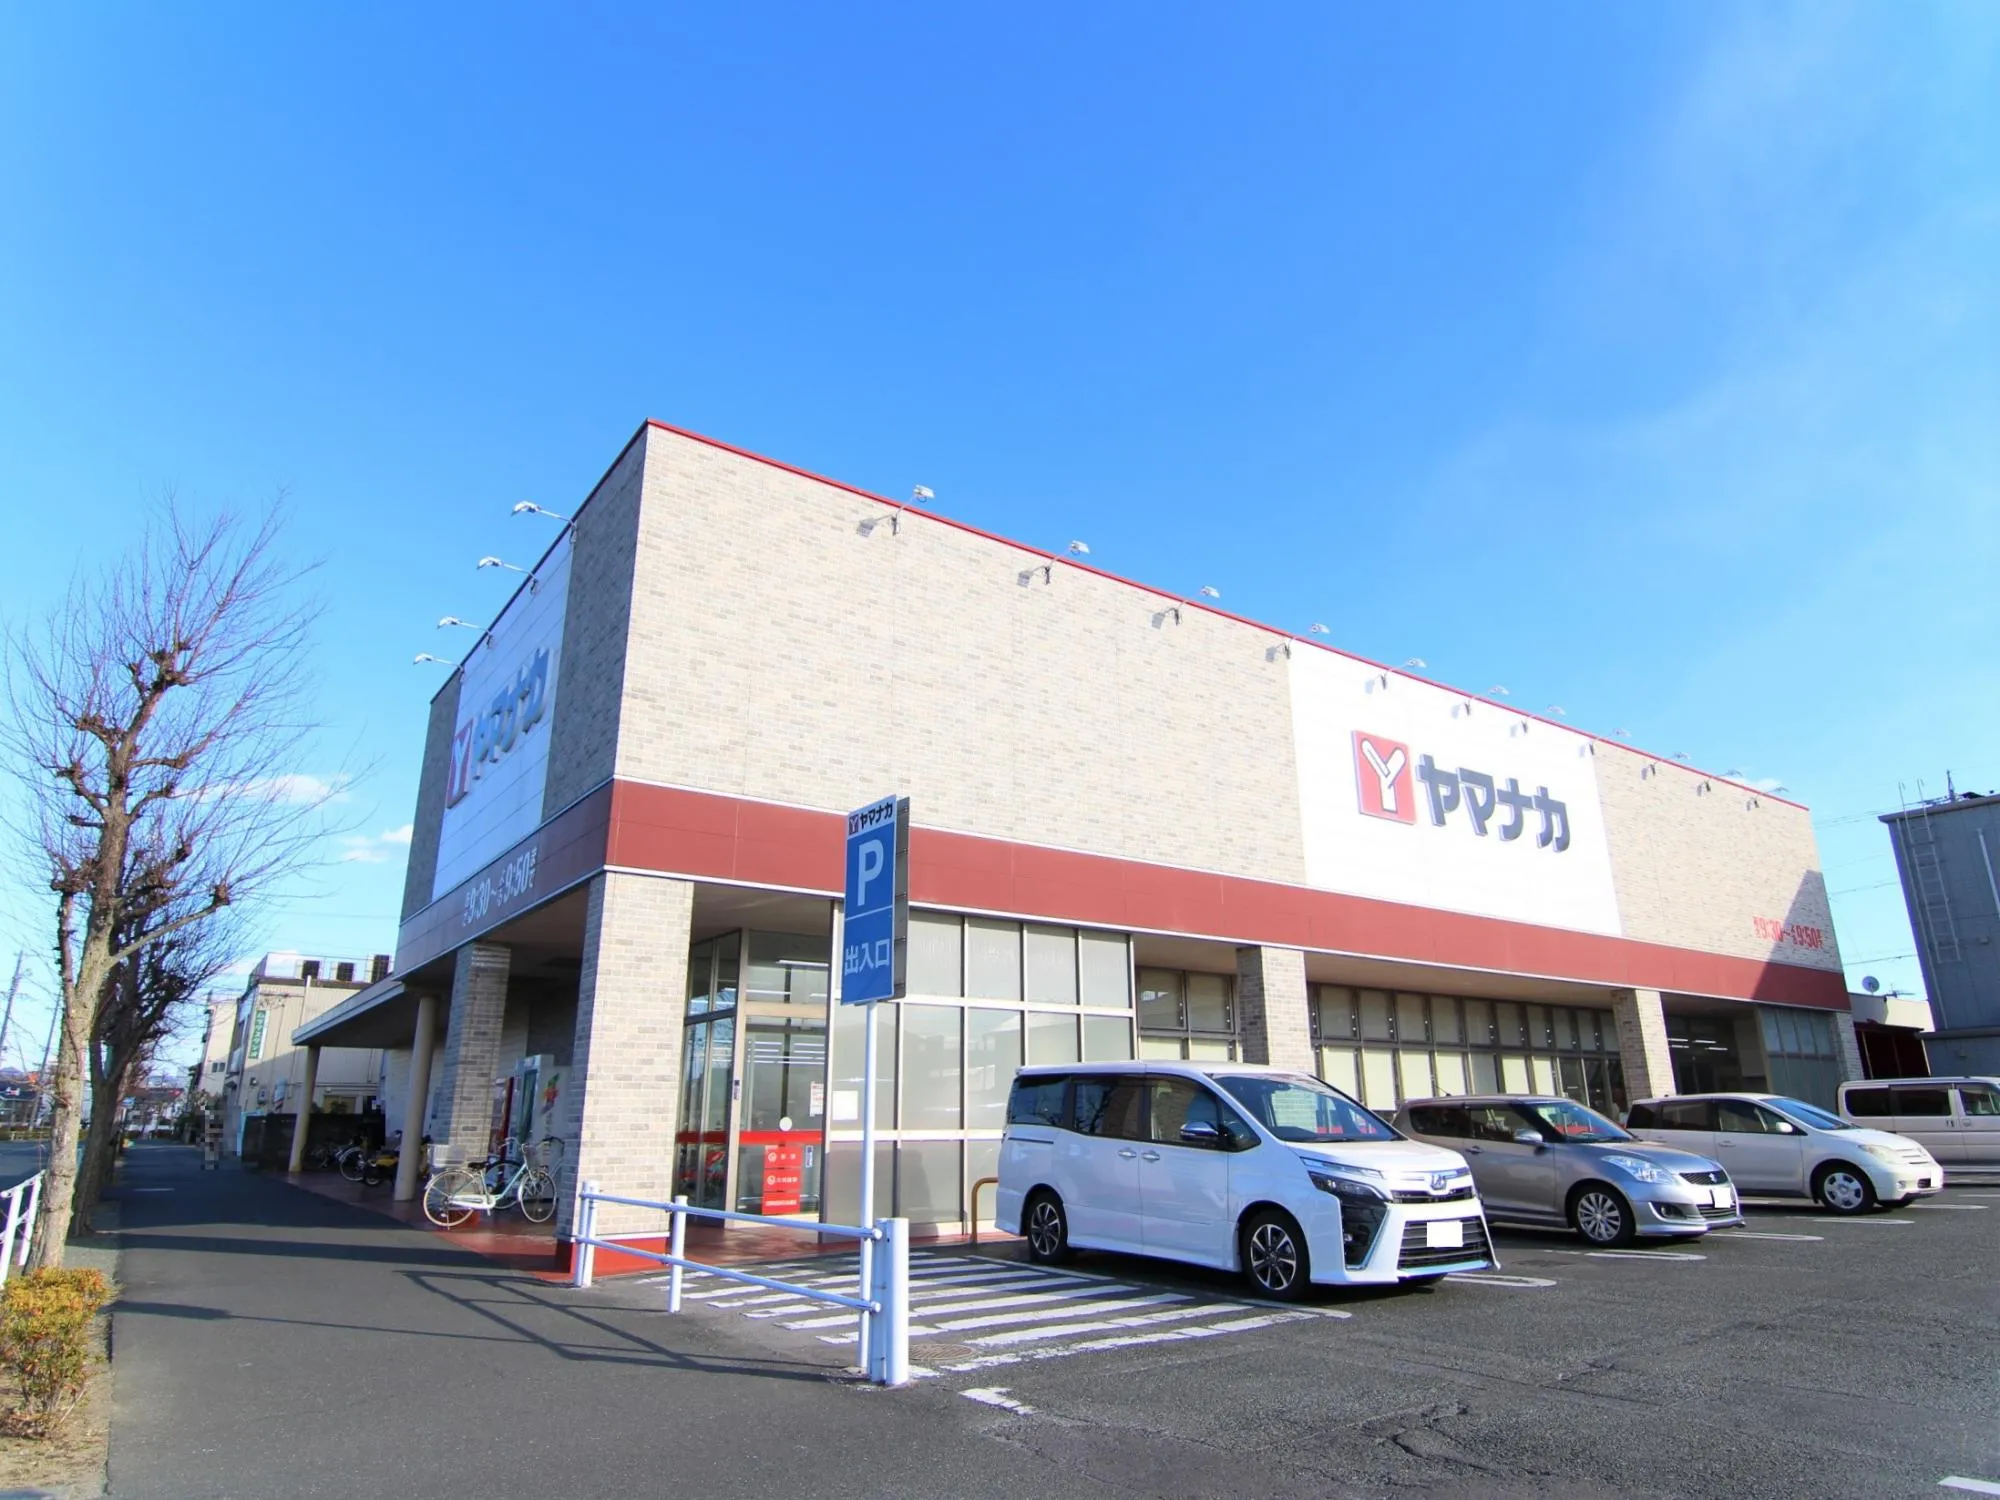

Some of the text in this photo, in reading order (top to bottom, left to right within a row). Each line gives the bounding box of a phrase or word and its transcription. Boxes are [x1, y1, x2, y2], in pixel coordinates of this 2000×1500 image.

[860, 802, 894, 830] ヤマナカ
[1415, 753, 1571, 853] ヤマナカ
[857, 839, 885, 907] P
[844, 938, 891, 976] 出入口
